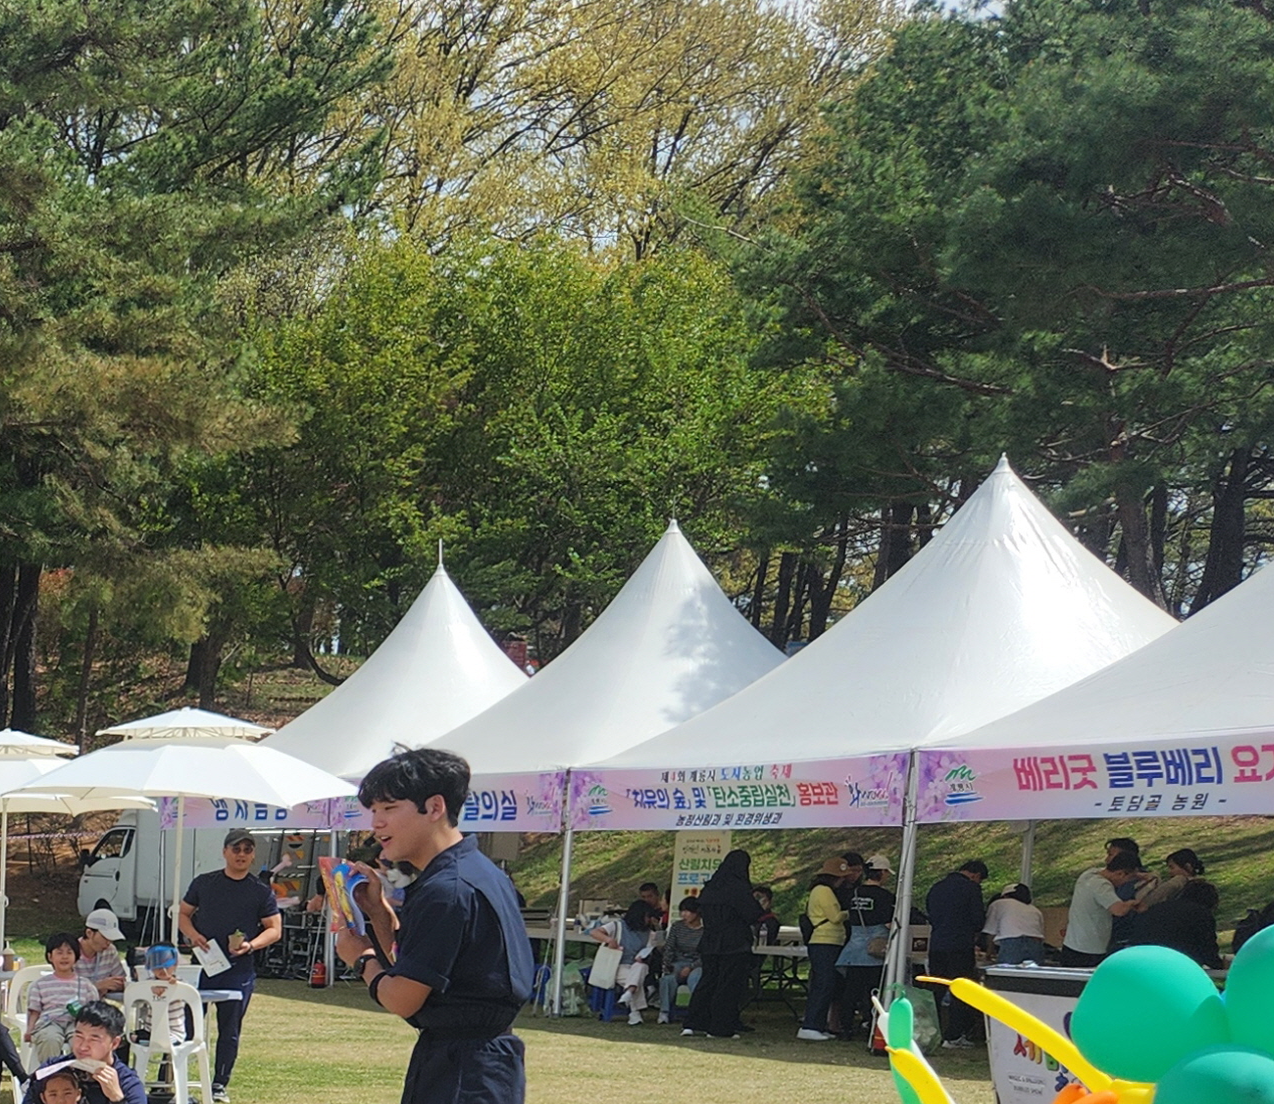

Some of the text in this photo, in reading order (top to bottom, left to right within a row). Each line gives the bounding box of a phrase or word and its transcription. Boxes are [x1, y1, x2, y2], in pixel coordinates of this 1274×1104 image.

[661, 763, 792, 784] 제4회 계룡시 도시농업 축제
[1013, 754, 1099, 791] 베리굿
[1103, 746, 1223, 789] 블루베리
[692, 786, 707, 809] 및
[796, 782, 839, 807] 홍보관
[1107, 793, 1162, 812] 토담골
[1171, 792, 1209, 811] 농원
[723, 813, 734, 826] 및
[734, 812, 783, 826] 환경위생과
